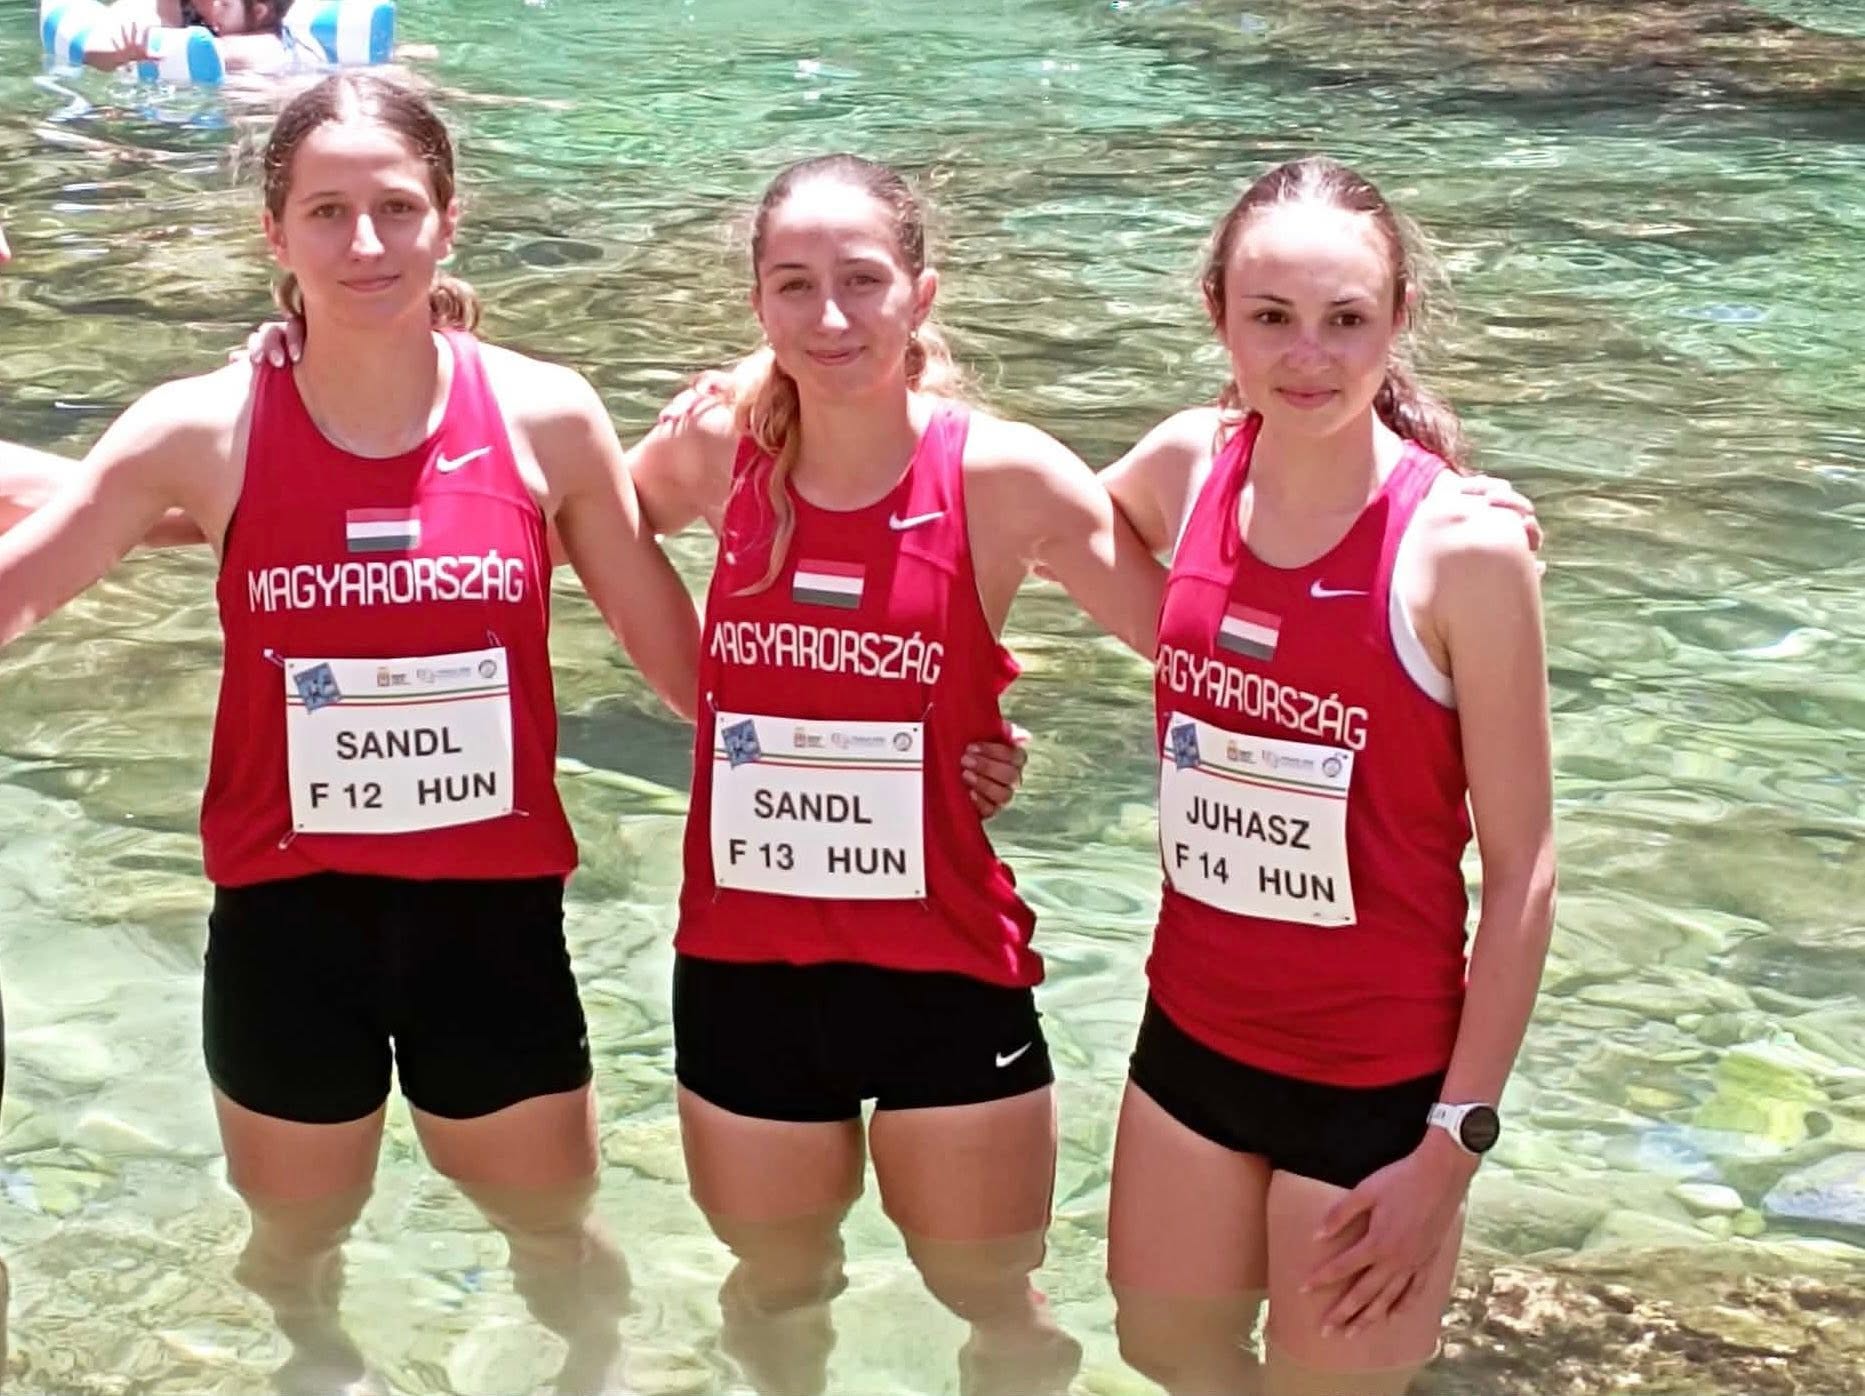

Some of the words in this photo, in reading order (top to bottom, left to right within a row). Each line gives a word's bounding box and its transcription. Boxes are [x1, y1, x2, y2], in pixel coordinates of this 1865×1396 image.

[249, 549, 525, 613] MAGYARORSZÁG
[1156, 644, 1369, 751] AGYARORSZÁG
[336, 726, 463, 761] SANDL
[310, 782, 329, 808] F
[344, 782, 382, 809] 12
[417, 771, 497, 806] HUN
[754, 789, 873, 825] SANDL
[1186, 796, 1312, 850] JUHASZ
[729, 838, 748, 865] F
[759, 843, 794, 871] 13
[827, 846, 906, 875] HUN
[1175, 843, 1190, 869] F
[1199, 852, 1229, 885] 14
[1259, 865, 1336, 903] HUN
